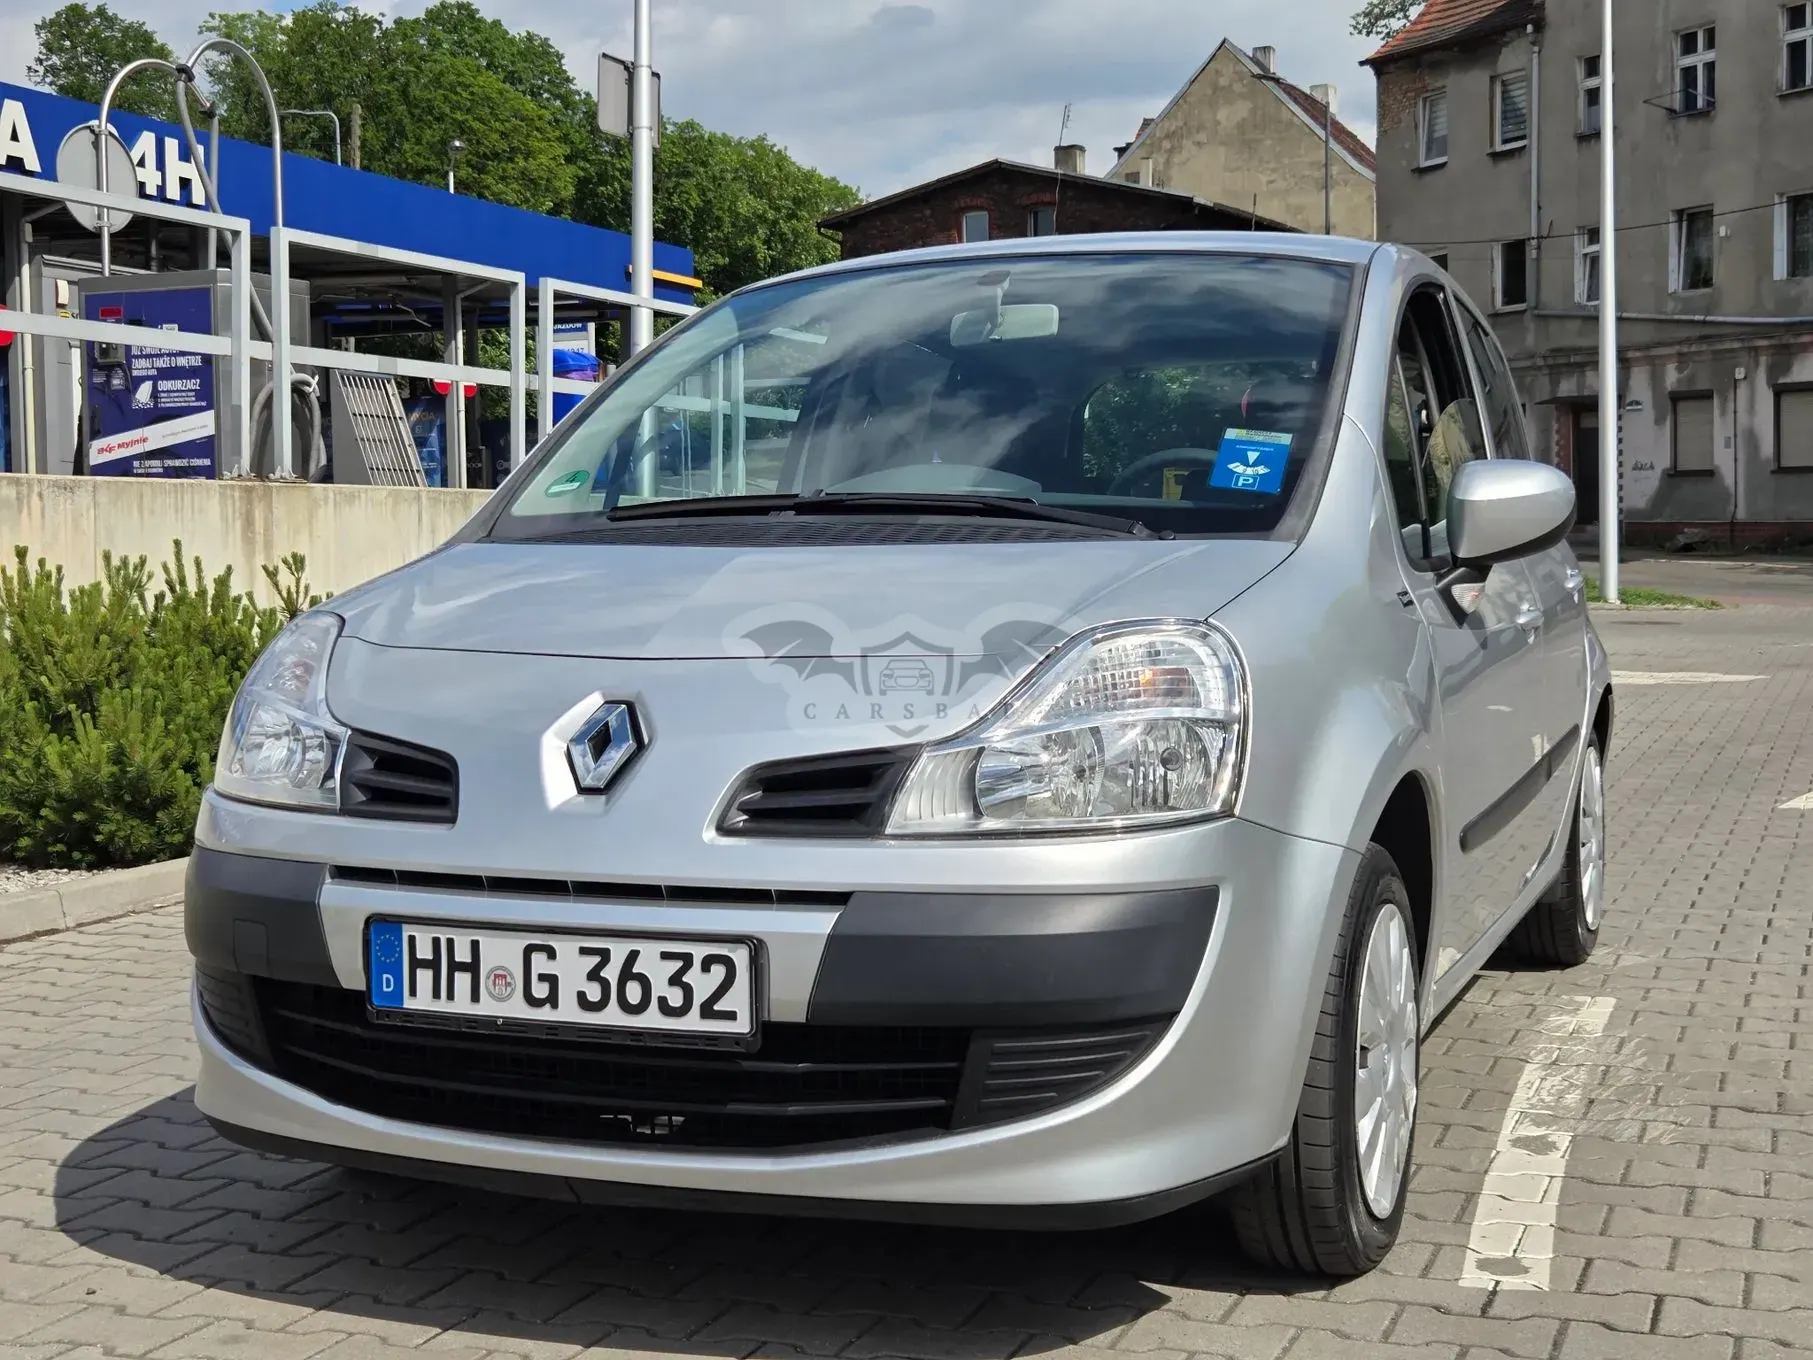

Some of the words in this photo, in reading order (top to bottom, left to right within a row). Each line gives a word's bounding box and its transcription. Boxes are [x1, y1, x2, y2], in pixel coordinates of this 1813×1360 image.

[0, 98, 42, 172] A
[88, 120, 206, 206] 4H
[171, 357, 176, 367] O
[158, 379, 200, 390] ODKURZACZ
[117, 436, 149, 450] Myjnie
[1238, 477, 1254, 487] P
[382, 974, 395, 992] D
[408, 934, 481, 1003] HH
[522, 942, 560, 1010] G
[576, 945, 738, 1021] 3632
